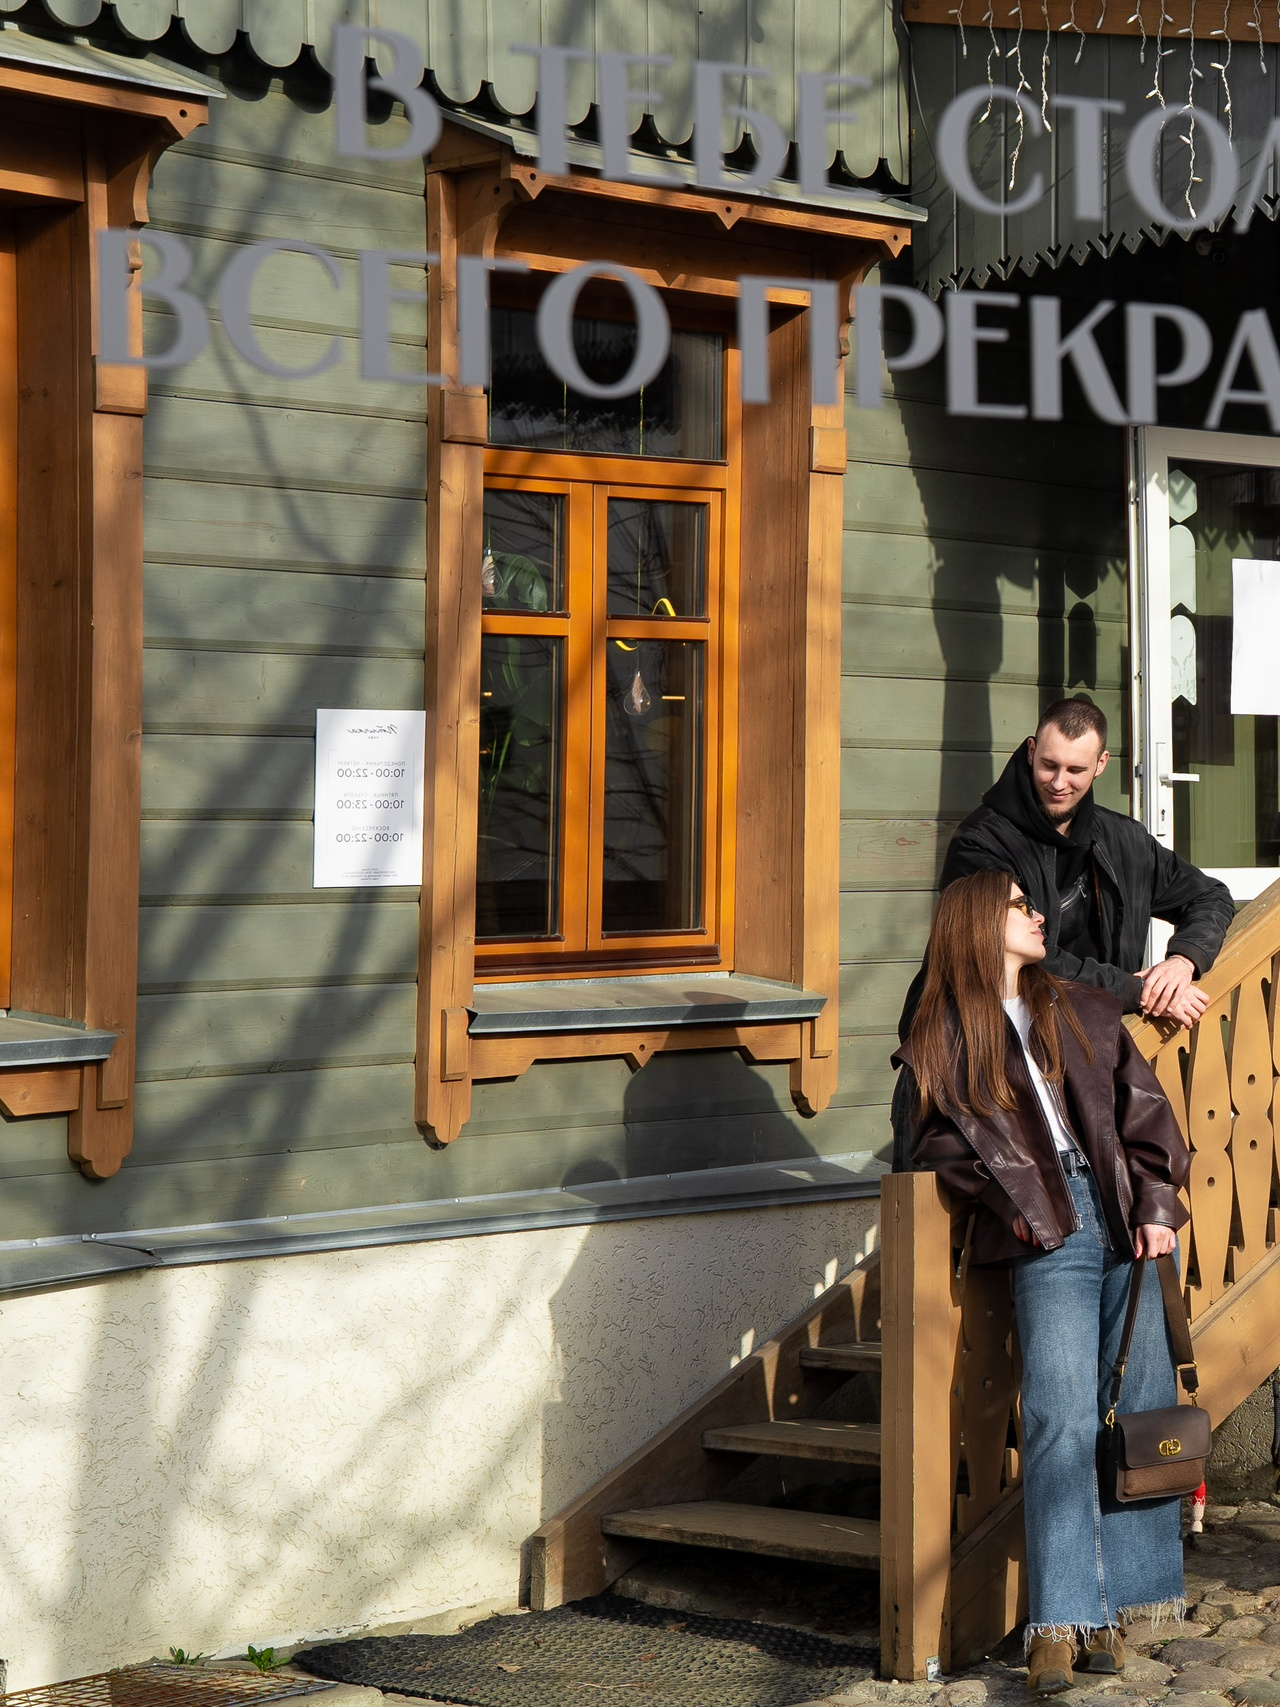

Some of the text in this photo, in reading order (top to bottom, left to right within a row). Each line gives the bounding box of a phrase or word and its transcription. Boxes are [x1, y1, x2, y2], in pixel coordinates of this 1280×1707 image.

[334, 24, 443, 161] В
[511, 43, 880, 200] ТЕБЕ
[96, 227, 671, 399] ВСЕГО
